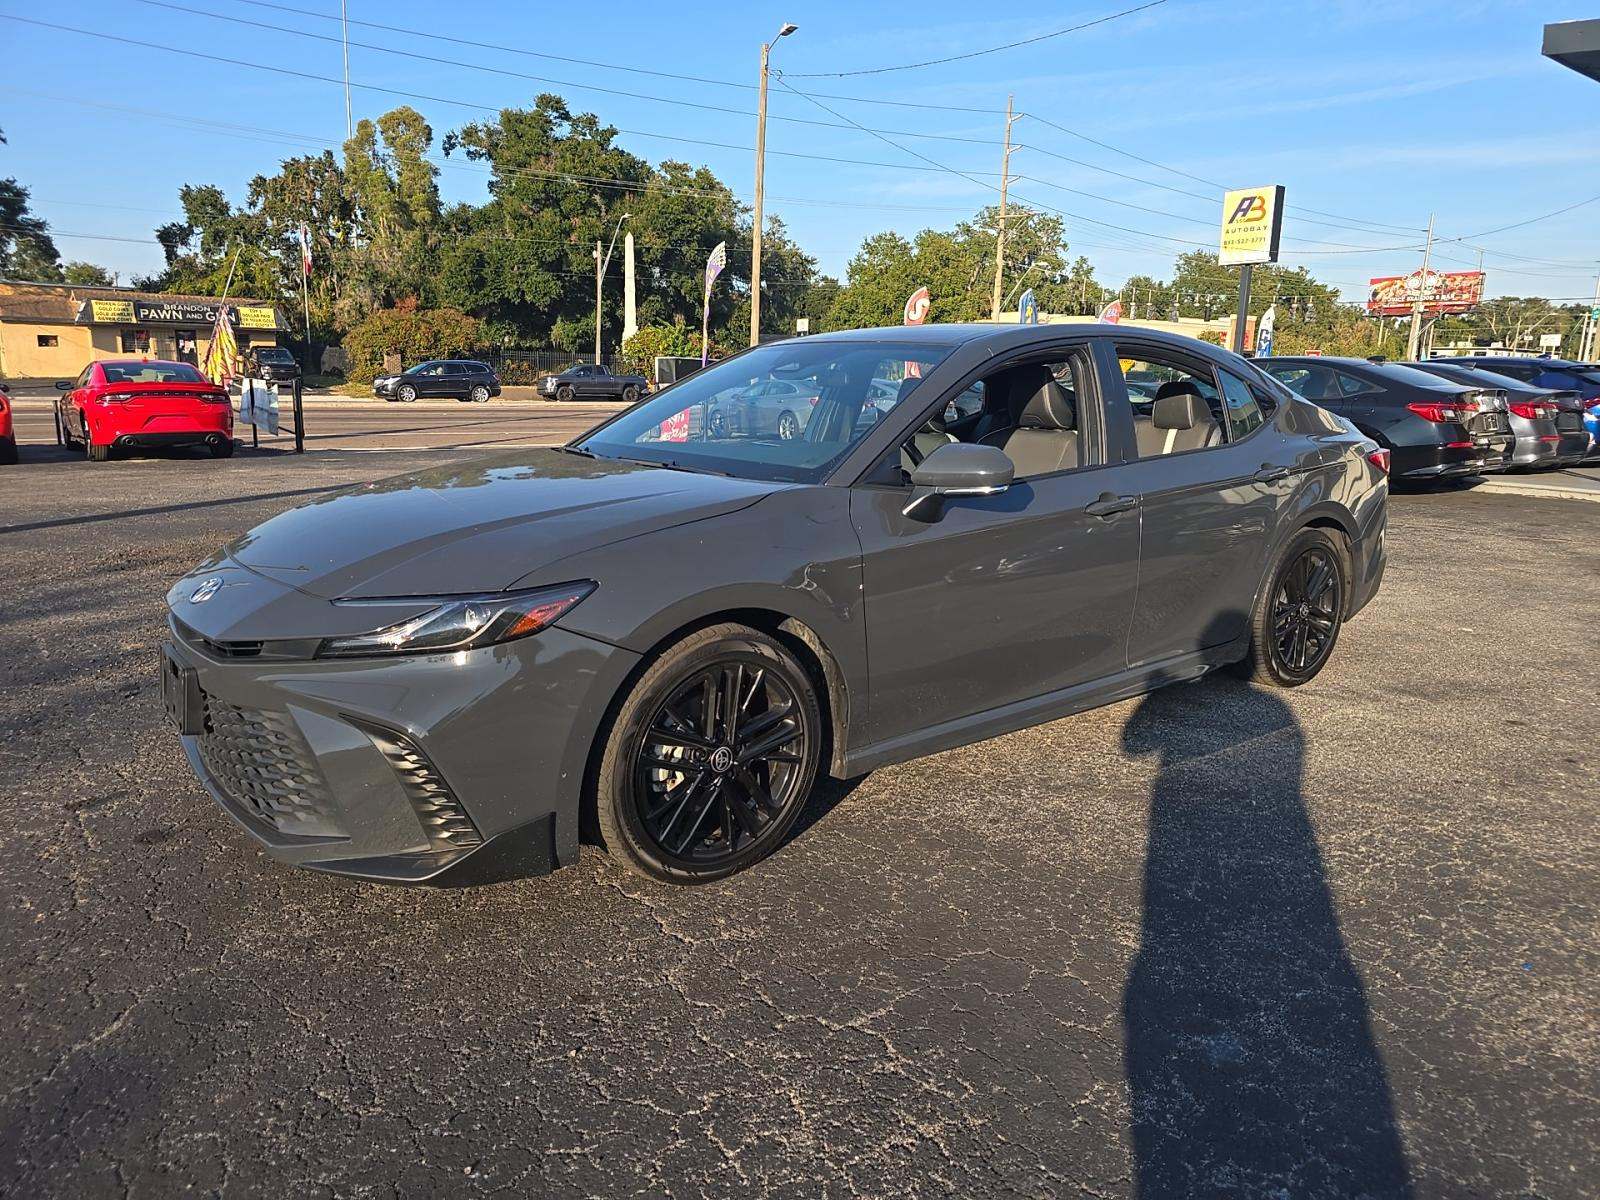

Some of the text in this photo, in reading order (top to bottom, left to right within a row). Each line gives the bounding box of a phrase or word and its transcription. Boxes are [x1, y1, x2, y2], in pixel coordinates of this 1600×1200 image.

[1225, 225, 1268, 234] AUTOBAY
[163, 303, 211, 312] BRANDON
[140, 308, 183, 320] PAWN
[205, 311, 236, 322] GN
